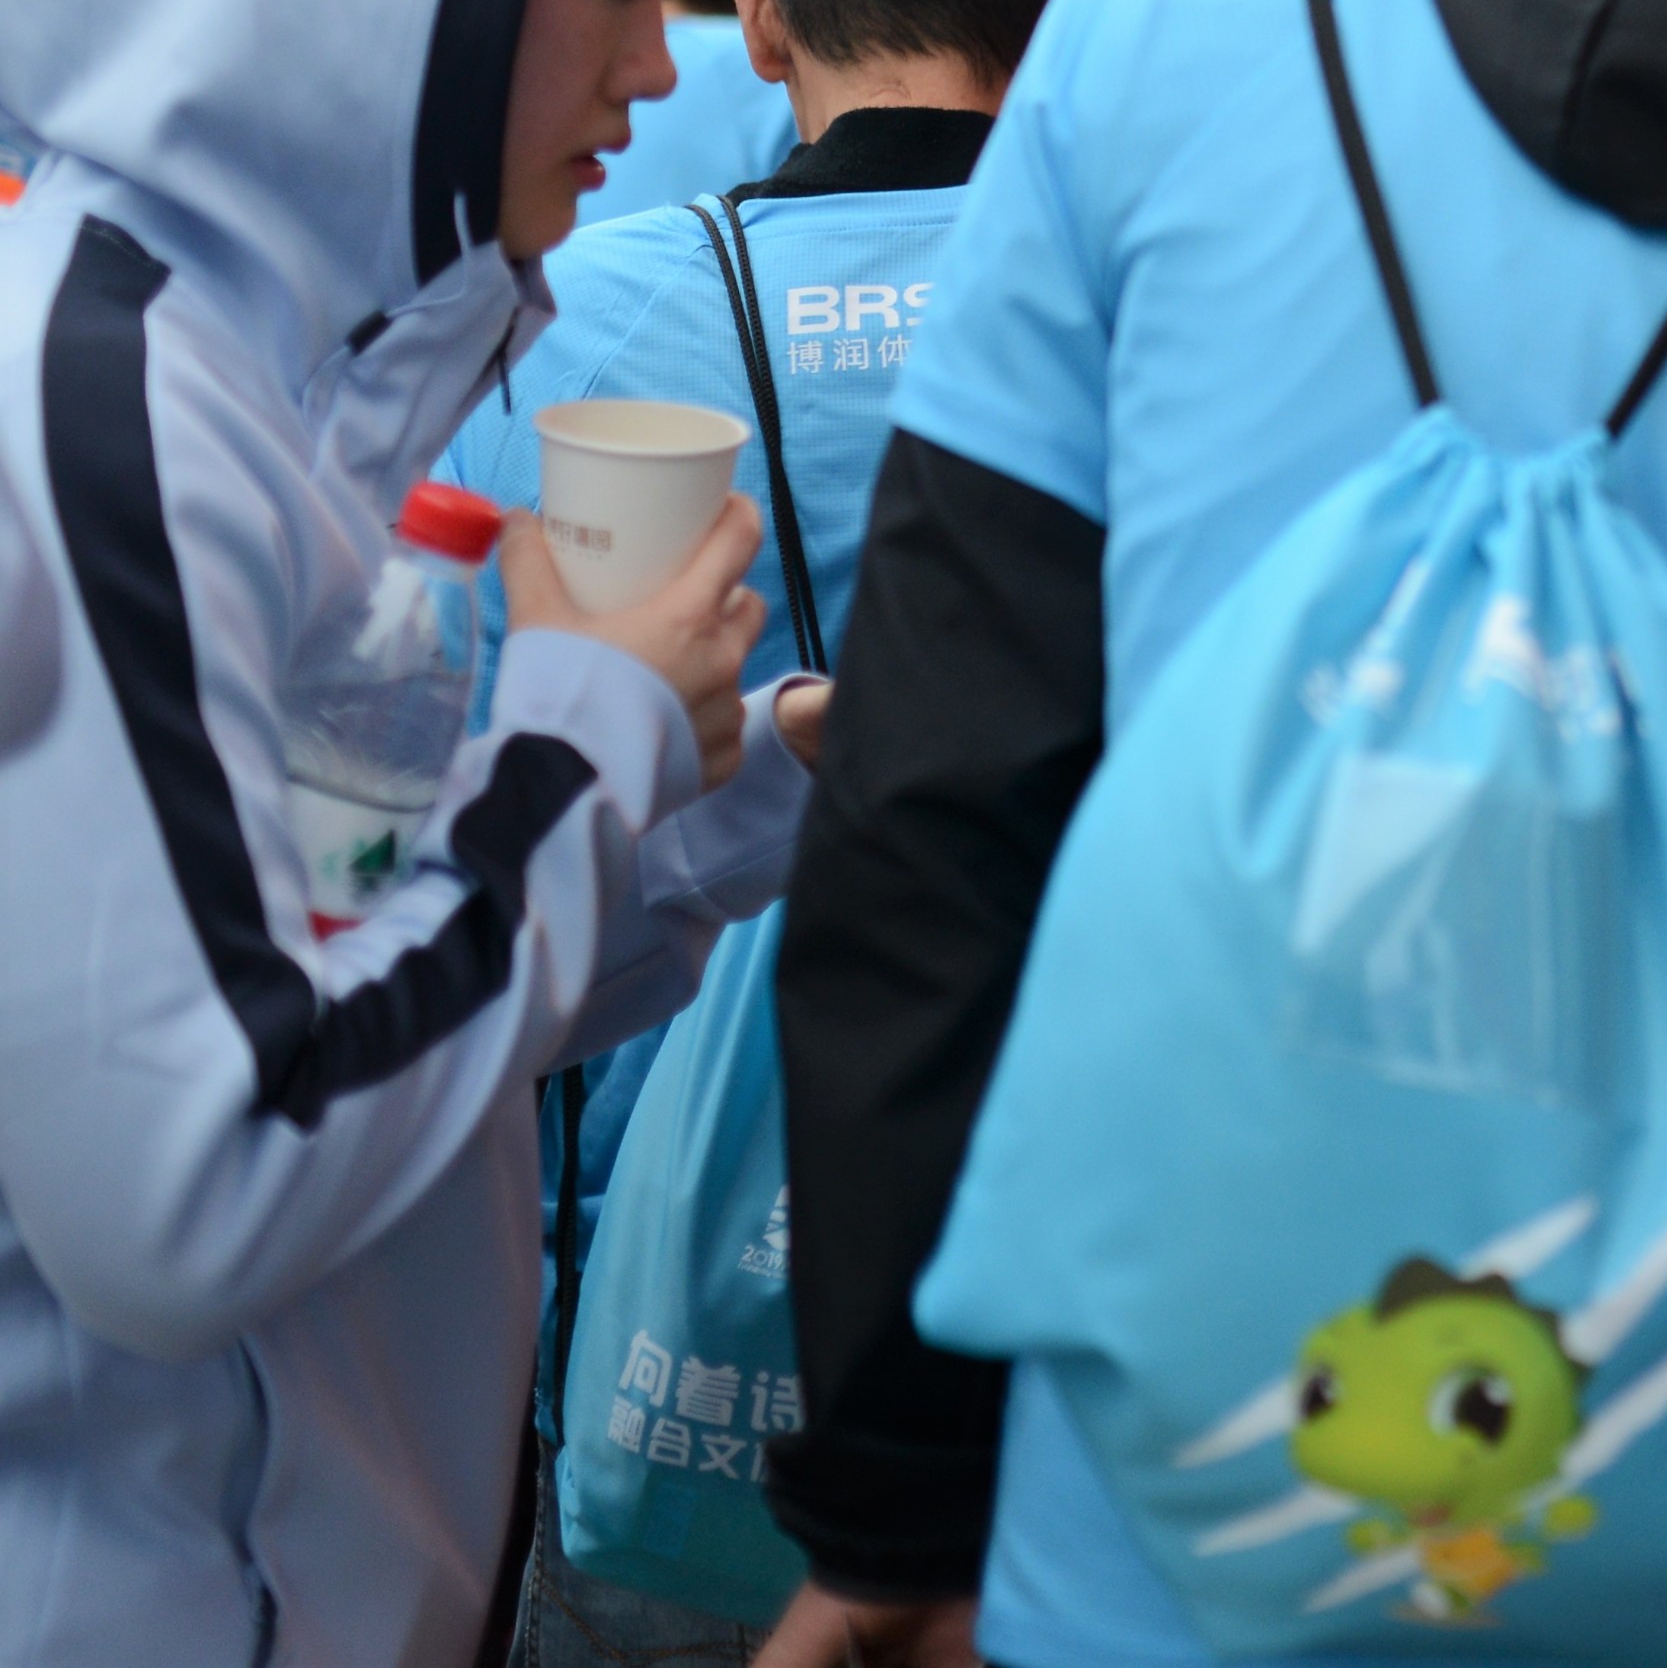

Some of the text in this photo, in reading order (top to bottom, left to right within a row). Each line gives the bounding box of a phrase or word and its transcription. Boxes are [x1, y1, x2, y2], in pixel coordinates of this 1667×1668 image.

[786, 335, 912, 375] 博润体
[618, 1329, 806, 1432] 向着诗
[607, 1393, 770, 1482] 融合文
